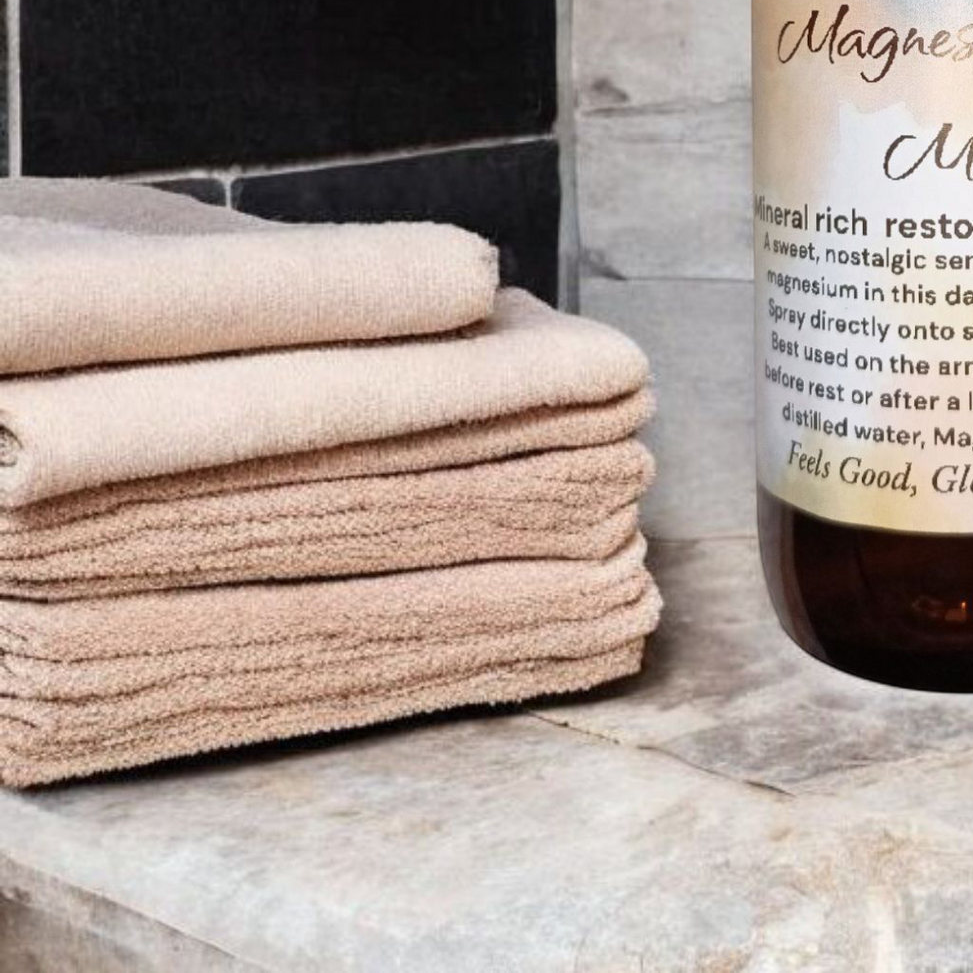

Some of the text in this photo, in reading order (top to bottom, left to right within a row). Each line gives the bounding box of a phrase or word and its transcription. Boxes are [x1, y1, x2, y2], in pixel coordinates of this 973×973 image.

[753, 195, 808, 231] Mineral
[815, 205, 868, 236] rich
[763, 231, 771, 251] A
[773, 239, 820, 265] sweet,
[825, 247, 927, 275] nostalgic
[766, 269, 858, 300] magnesium
[864, 281, 885, 302] in
[891, 283, 937, 306] this
[768, 297, 806, 330] Spray
[810, 308, 891, 343] directly
[897, 321, 955, 341] onto
[771, 330, 800, 358] Best
[804, 345, 849, 368] used
[855, 354, 883, 373] on
[889, 353, 931, 375] the
[764, 358, 805, 393] before
[808, 380, 845, 402] rest
[851, 388, 873, 406] or
[879, 388, 940, 411] after
[947, 395, 961, 411] a
[782, 401, 849, 438] distilled
[854, 424, 926, 450] water,
[788, 439, 831, 479] Feels
[839, 455, 918, 497] Good,
